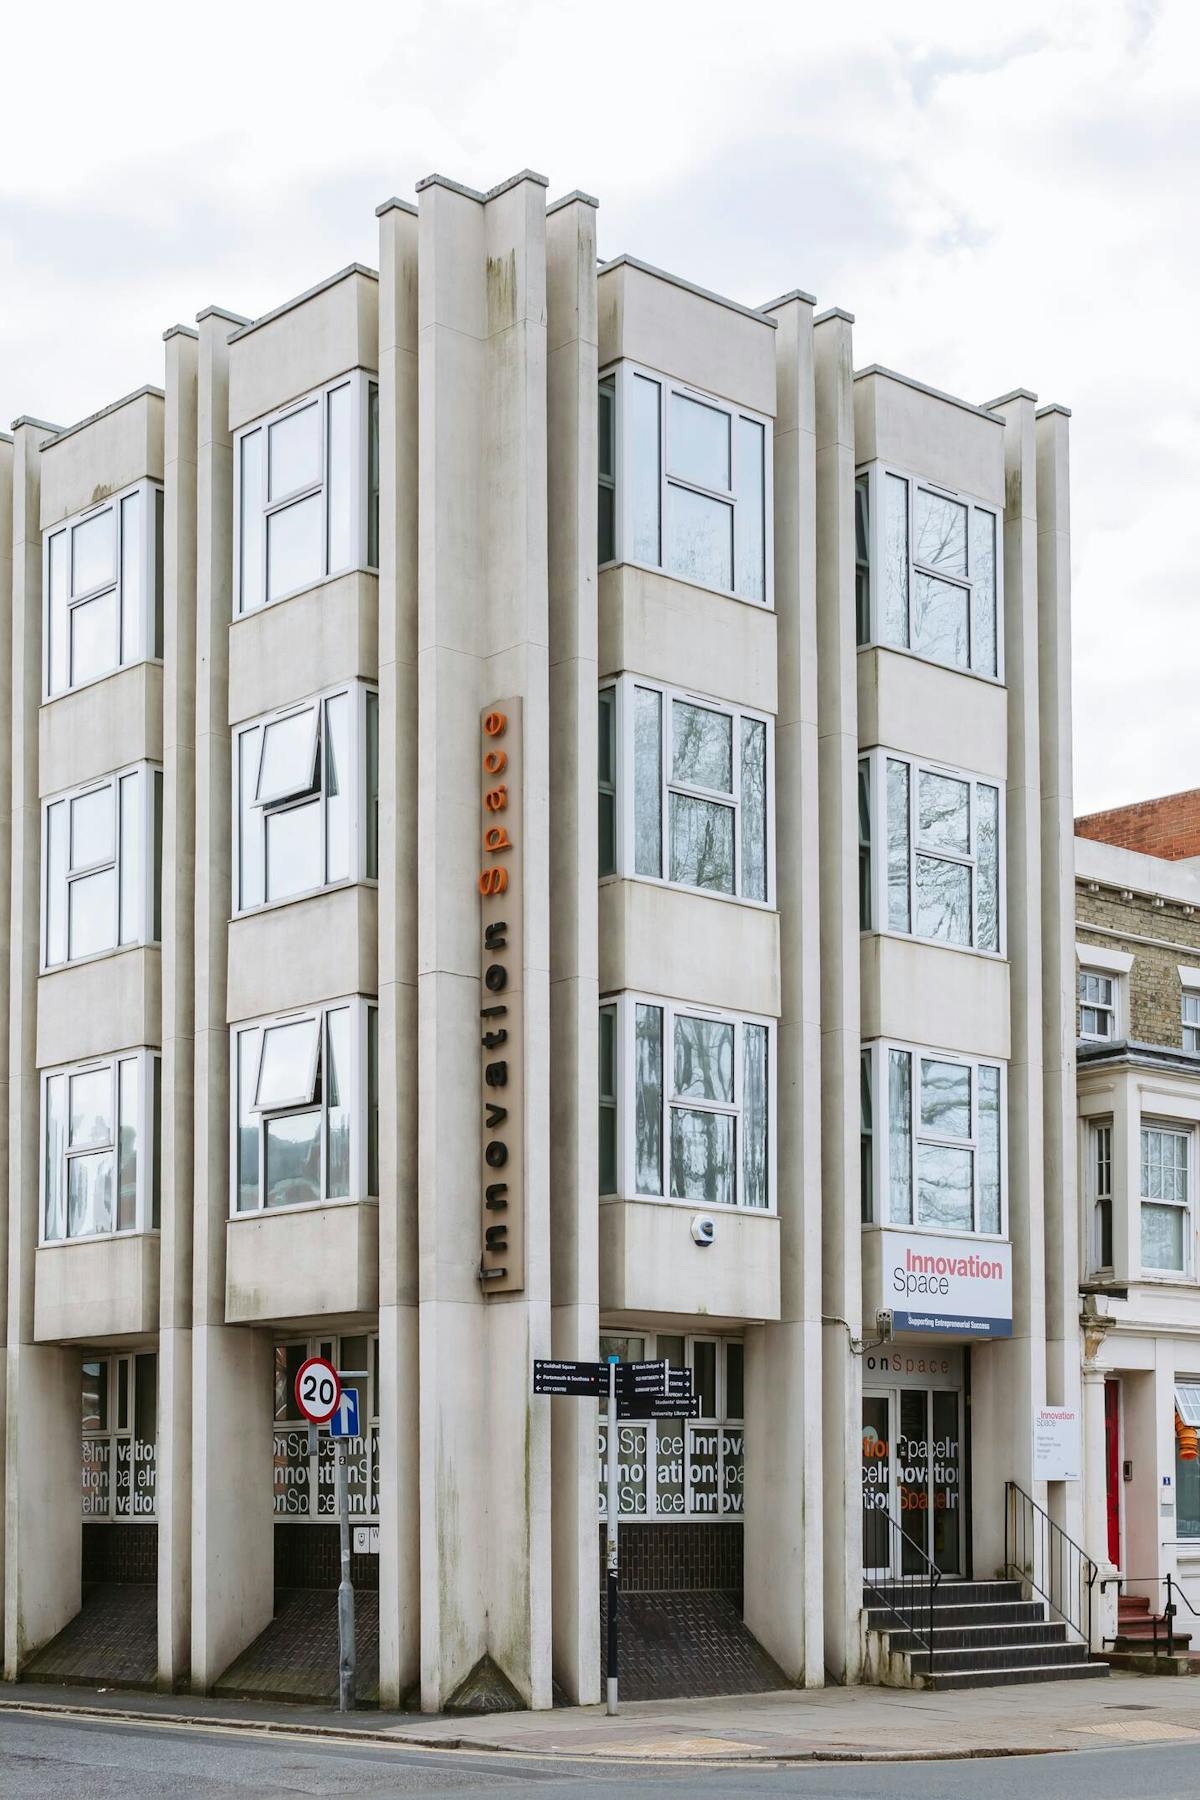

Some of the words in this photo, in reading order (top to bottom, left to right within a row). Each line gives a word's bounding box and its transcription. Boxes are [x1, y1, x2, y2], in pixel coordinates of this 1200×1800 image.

[479, 711, 513, 897] Space
[480, 921, 508, 1282] Innovation
[906, 1248, 1003, 1280] Innovation
[893, 1267, 949, 1298] Space
[908, 1317, 935, 1329] Supporting
[934, 1319, 971, 1329] Entrepreneurial
[970, 1321, 991, 1330] Success
[543, 1362, 561, 1370] Guildhall
[543, 1374, 566, 1382] Portsmouth
[303, 1375, 335, 1405] 20
[651, 1410, 674, 1418] University
[673, 1410, 690, 1418] Library
[1040, 1410, 1075, 1421] Innovation
